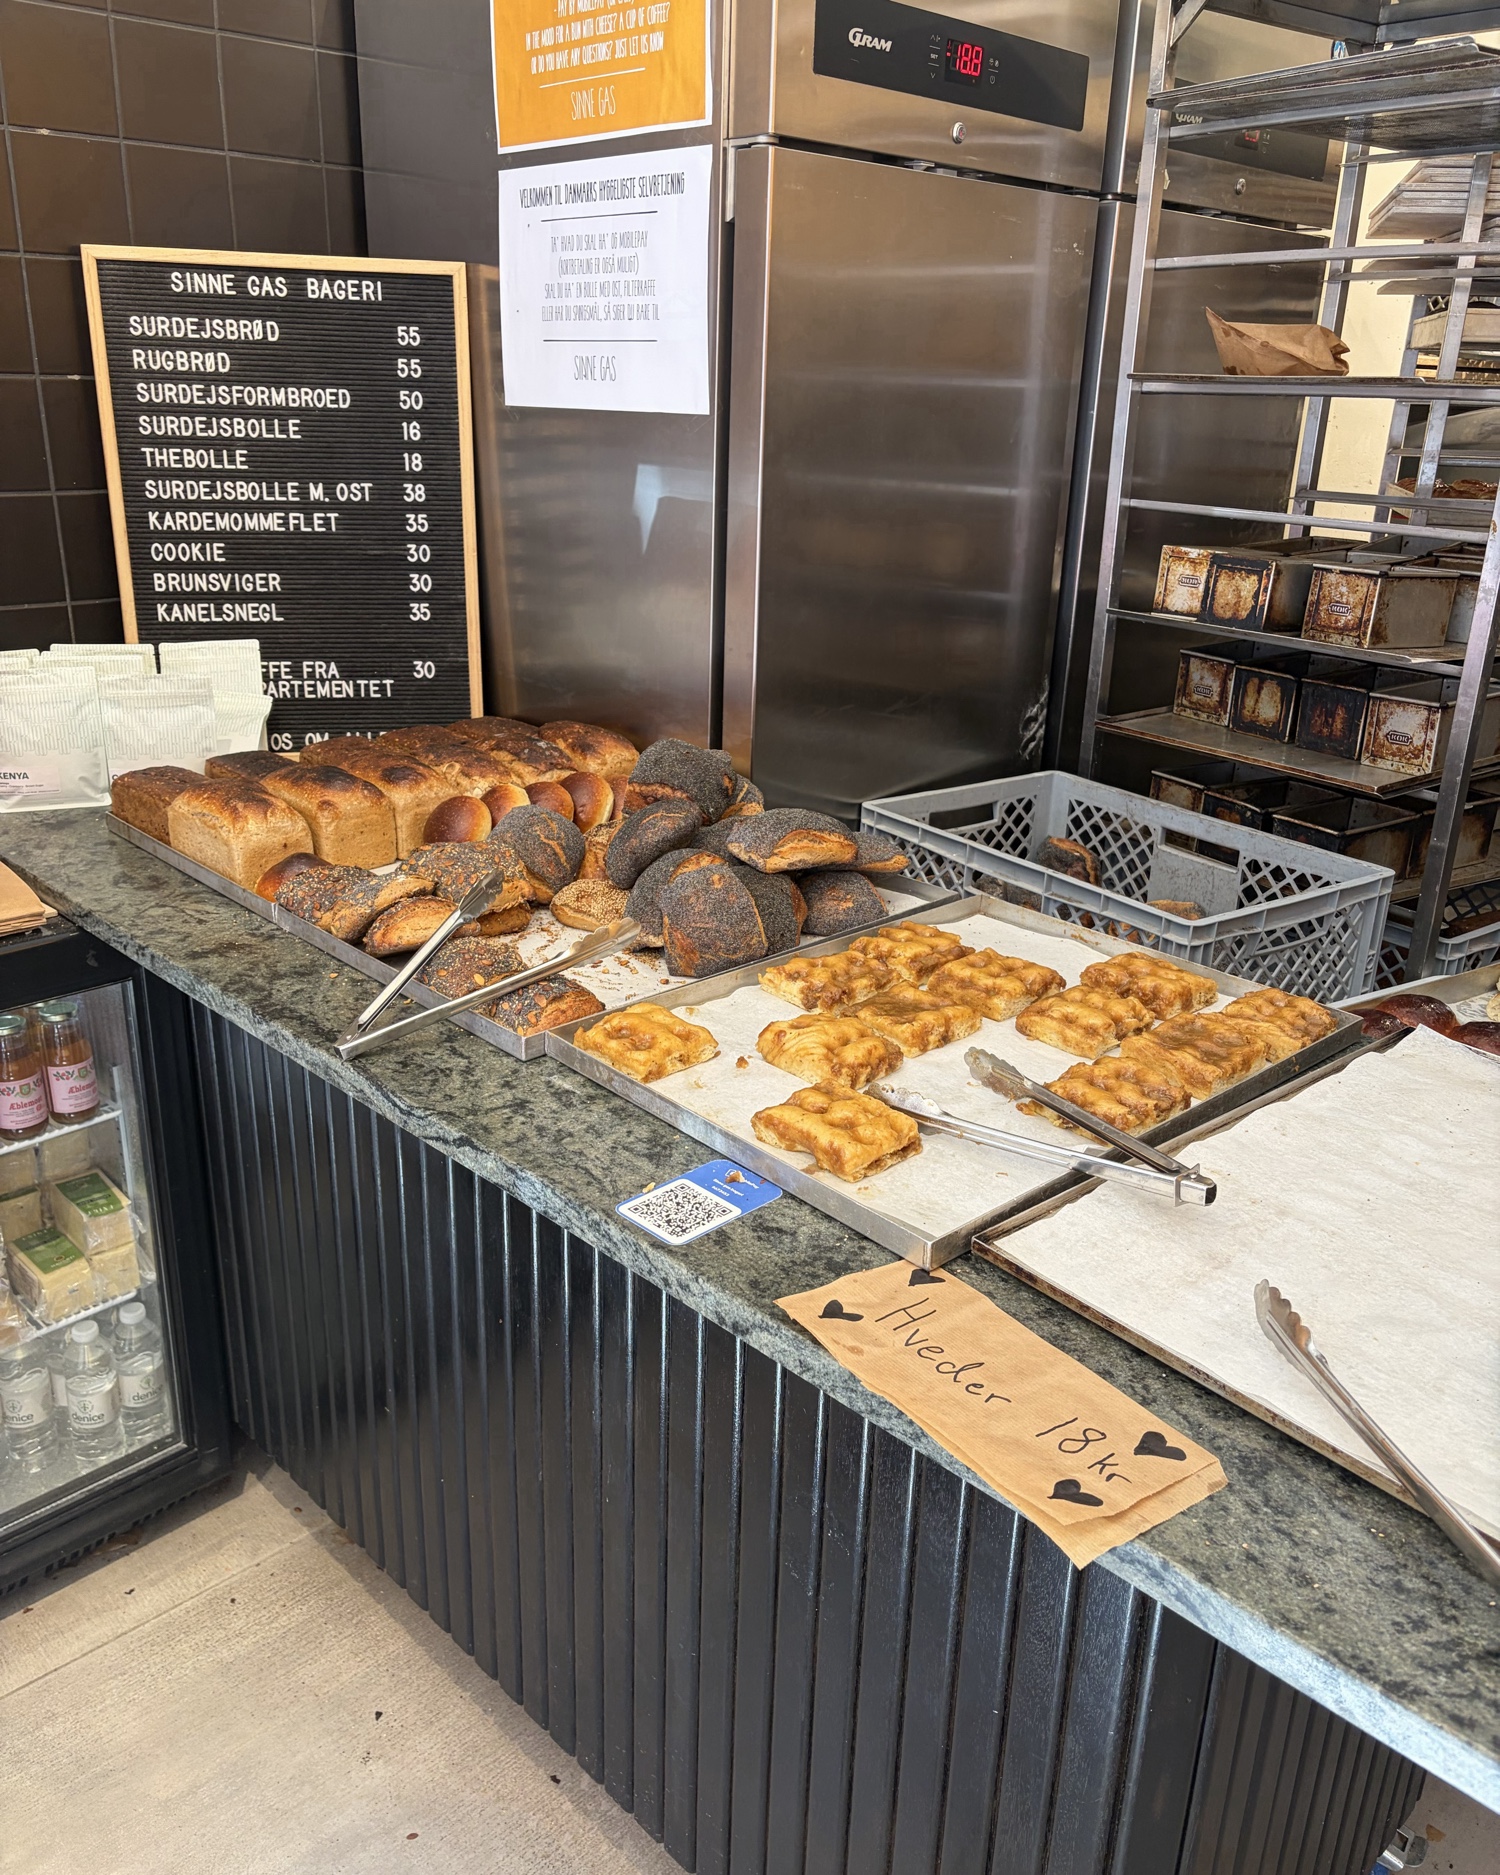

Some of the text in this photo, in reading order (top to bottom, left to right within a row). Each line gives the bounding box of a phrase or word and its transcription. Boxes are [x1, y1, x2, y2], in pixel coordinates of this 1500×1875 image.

[532, 30, 540, 50] THE
[541, 26, 554, 48] MOOD
[555, 24, 564, 45] FOR
[565, 23, 570, 43] A
[571, 20, 581, 42] BUN
[582, 17, 594, 39] WITH
[595, 12, 618, 36] CHEESE?
[619, 11, 624, 31] A
[625, 8, 637, 30] CUP
[637, 6, 646, 28] OF
[646, 1, 671, 26] COFFEE?
[530, 30, 664, 75] OR DO YOU HAVE ANY QUESTIONS? JUST LET US KNOW
[848, 27, 893, 53] GRAM
[570, 84, 616, 121] SINNE GAS
[519, 171, 685, 209] VELKOMMEN TIL DANMARKS HYGGELIGSTE SELVBETJENING
[560, 234, 575, 252] HVAD
[575, 234, 584, 251] DU
[584, 233, 597, 251] SKAL
[610, 231, 618, 250] OG
[619, 230, 649, 249] MOBILEPAY
[594, 256, 601, 275] ER
[601, 253, 616, 274] OGSÅ
[616, 251, 640, 276] MULIGT)
[171, 272, 382, 301] SINNE GAS BAGERI
[544, 282, 556, 300] SKAL
[556, 281, 564, 299] DU
[575, 280, 583, 299] EN
[583, 280, 598, 298] BOLLE
[599, 280, 611, 298] MED
[611, 280, 623, 299] OST,
[623, 278, 656, 297] FILTERKAFFE
[541, 305, 554, 322] ELLER
[554, 304, 564, 321] HAR
[564, 304, 572, 321] DU
[603, 301, 612, 321] SÅ
[612, 303, 626, 321] SIGER
[636, 303, 651, 321] BARE
[652, 304, 660, 321] TIL
[129, 316, 420, 346] SURDEJSBRØD 55
[132, 349, 422, 378] RUGBRØD 55
[573, 354, 617, 383] SINNE GAS
[136, 383, 423, 410] SURDEJSFORMBROED 50
[139, 416, 421, 441] SURDEJSBOLLE 16
[141, 448, 423, 472] THEBOLLE 18
[145, 480, 426, 502] SURDEJSBOLLE M. OST 38
[148, 511, 429, 532] KARDEMOMMEFLET 35
[151, 543, 431, 562] COOKIE 30
[153, 573, 432, 593] BRUNSVIGER 30
[157, 603, 431, 622] KANELSNEGL 35
[303, 661, 340, 679] FRA
[413, 661, 436, 680] 30
[271, 733, 293, 751] OS
[875, 1298, 1012, 1404] Hveder
[71, 1411, 105, 1423] denice
